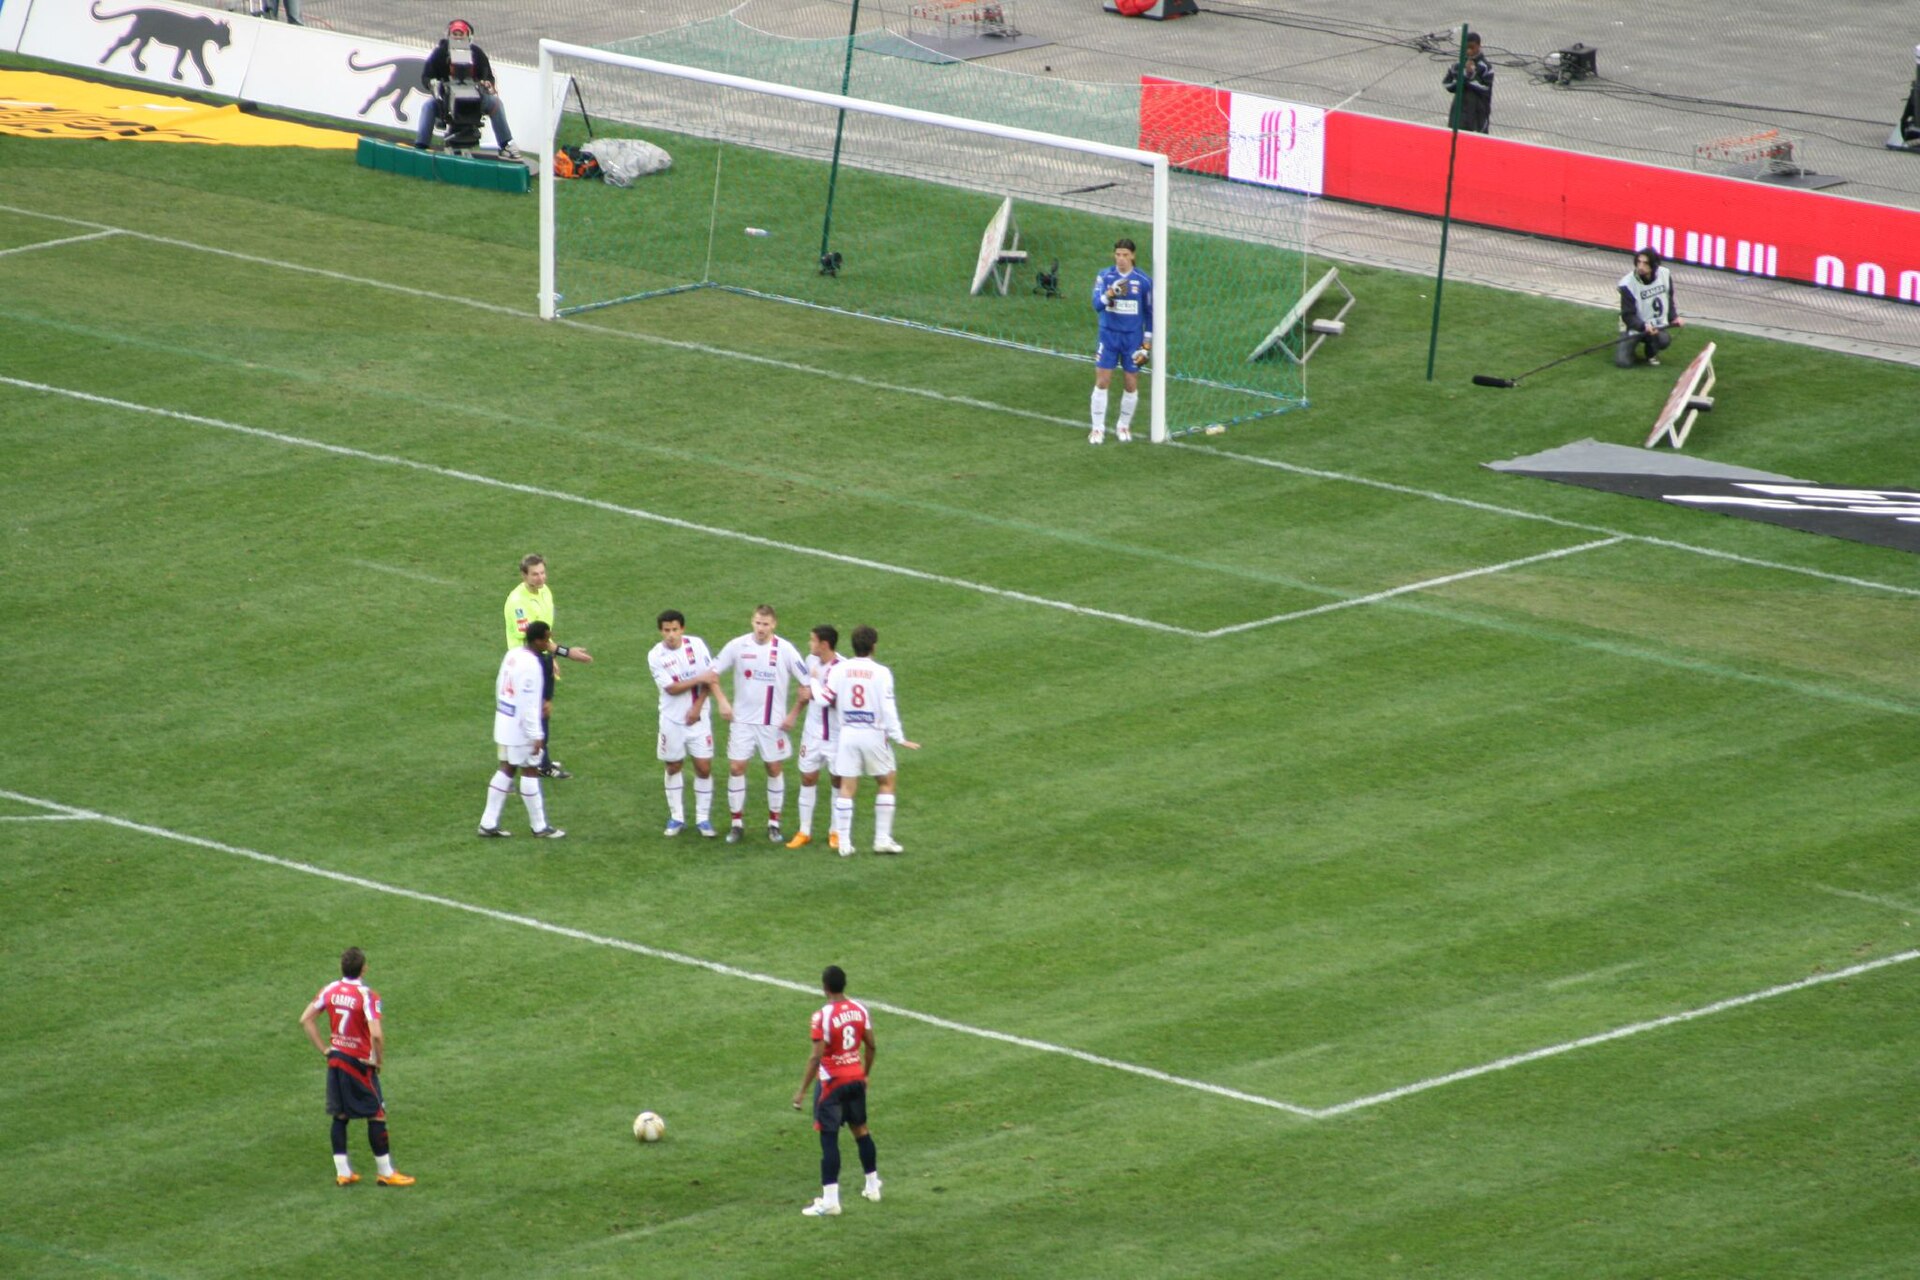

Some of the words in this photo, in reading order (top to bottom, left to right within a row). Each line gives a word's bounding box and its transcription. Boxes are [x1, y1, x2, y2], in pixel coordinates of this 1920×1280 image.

[1652, 297, 1664, 319] 9
[851, 684, 865, 708] 8
[335, 1008, 350, 1035] 7
[842, 1025, 856, 1050] 8
